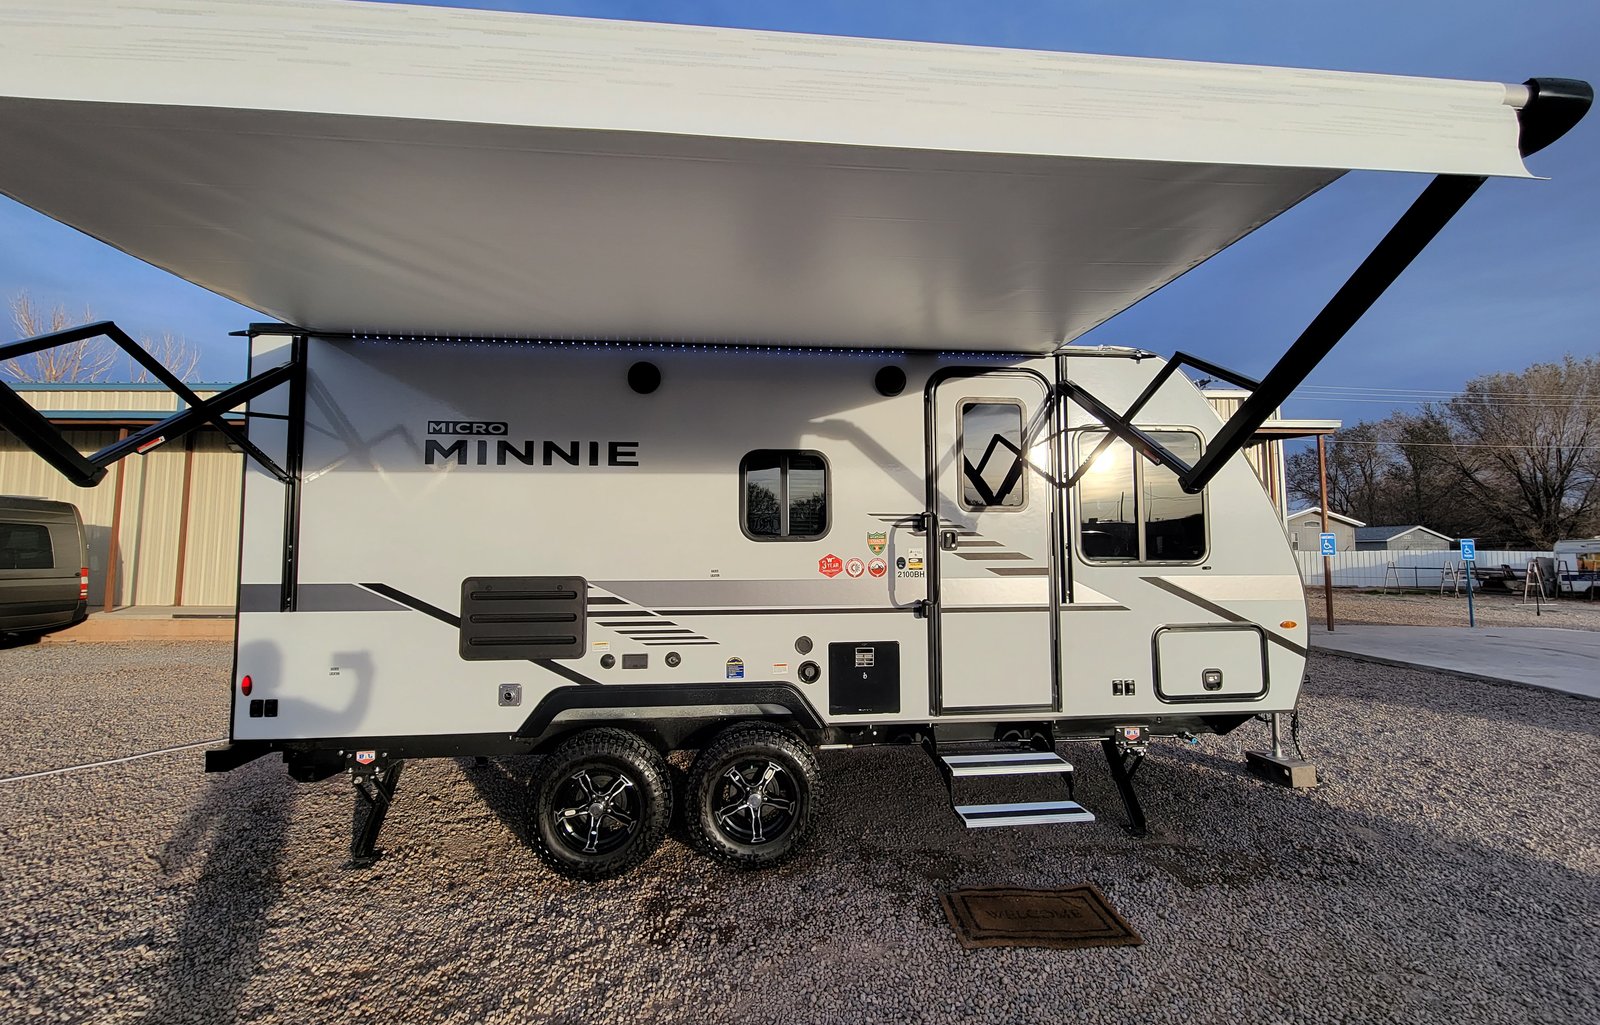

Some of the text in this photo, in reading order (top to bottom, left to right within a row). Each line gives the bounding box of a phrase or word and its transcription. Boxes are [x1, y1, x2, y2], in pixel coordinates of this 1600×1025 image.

[428, 422, 506, 435] MICRO
[424, 439, 640, 467] MINNIE
[821, 560, 827, 570] 3
[897, 570, 925, 578] 2100BH
[984, 908, 1083, 920] WELCOME
